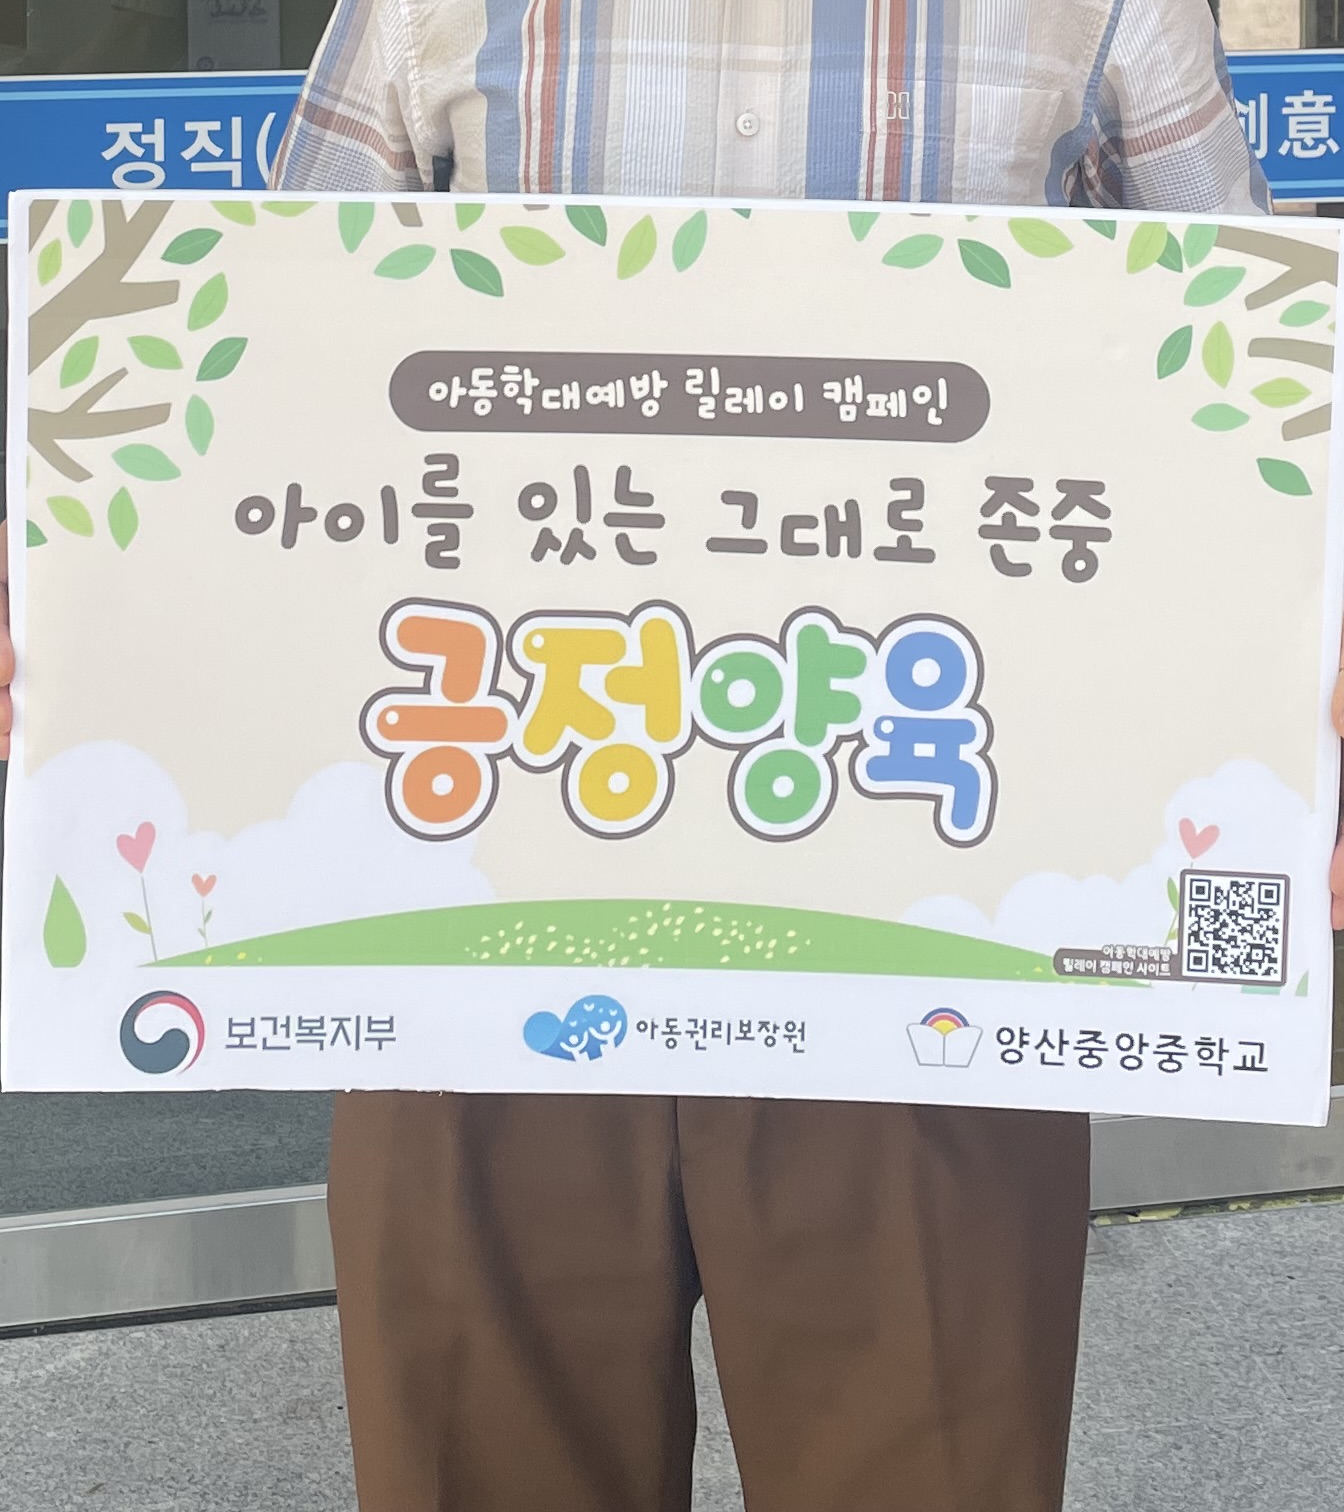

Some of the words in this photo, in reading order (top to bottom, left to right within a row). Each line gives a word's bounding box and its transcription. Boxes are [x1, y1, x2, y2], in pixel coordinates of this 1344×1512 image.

[429, 365, 668, 419] 아동학대예방
[684, 367, 805, 420] 릴레이
[822, 374, 950, 427] 캠페인
[234, 452, 475, 570] 아이를
[516, 463, 666, 566] 있는
[705, 476, 937, 565] 그대로
[977, 474, 1113, 584] 존중
[362, 601, 996, 845] 긍정양육
[224, 1014, 398, 1053] 보건복지부
[635, 1016, 807, 1055] 아동권리보장원
[995, 1025, 1270, 1076] 양산중앙중학교
